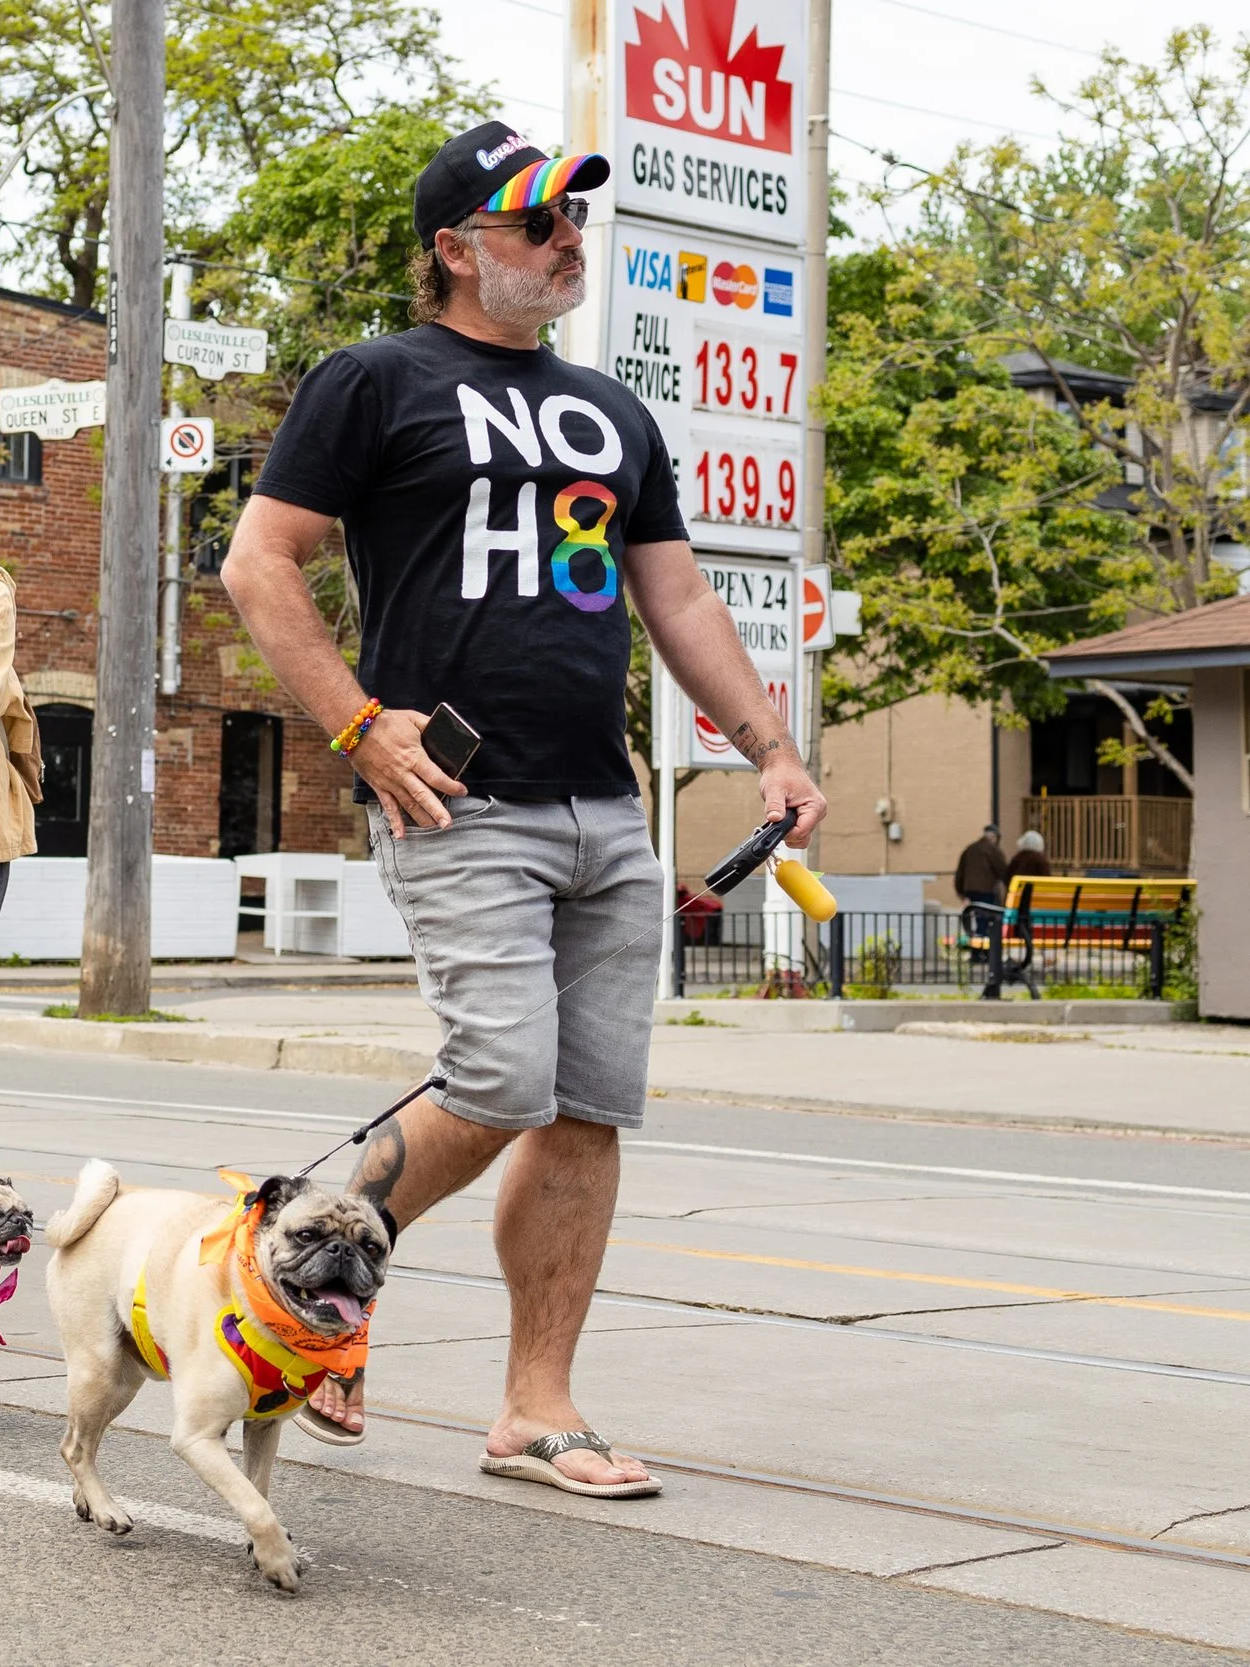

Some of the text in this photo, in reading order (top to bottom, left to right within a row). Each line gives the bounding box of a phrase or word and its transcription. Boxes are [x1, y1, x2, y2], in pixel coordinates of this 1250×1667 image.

[652, 57, 766, 141] SUN
[476, 141, 518, 171] love
[632, 142, 787, 216] GAS SERVICES
[622, 245, 672, 293] VISA
[177, 343, 225, 367] CURZON
[181, 328, 248, 348] LESLIEVILLE
[633, 313, 671, 356] FULL
[15, 391, 91, 408] LESLIEVILLE
[615, 355, 681, 403] SERVICE
[696, 340, 798, 415] 133.7
[5, 405, 100, 429] QUEEN ST E
[456, 383, 624, 476] NO
[696, 450, 796, 523] 139.9
[461, 477, 618, 613] H8
[761, 574, 788, 611] 24
[738, 620, 789, 652] HOURS
